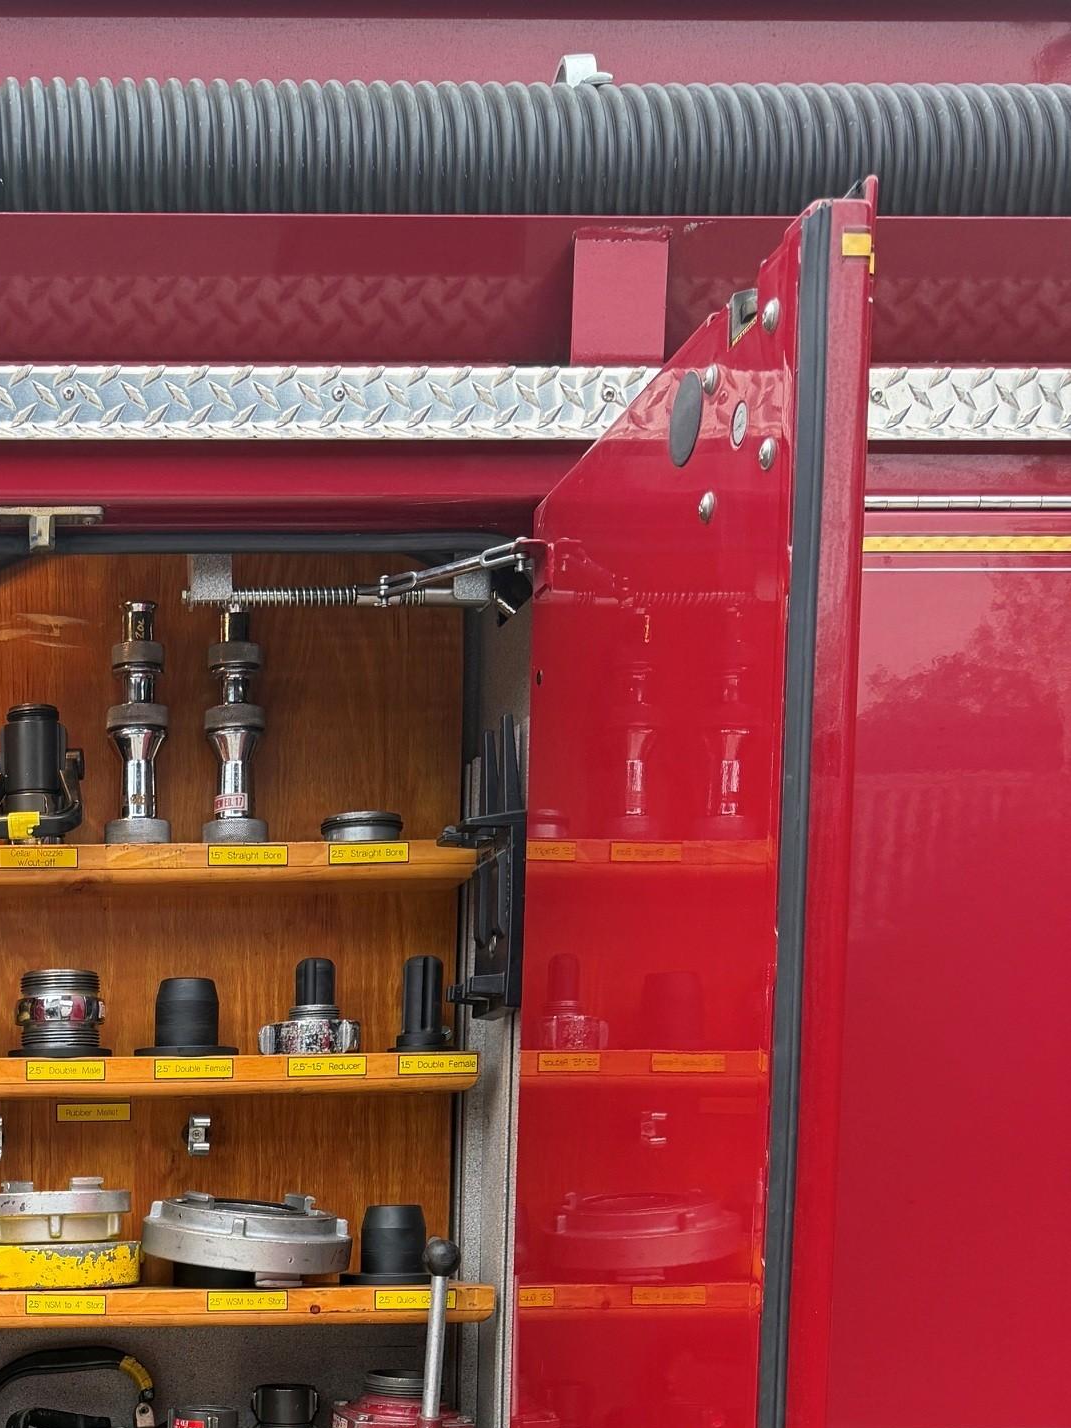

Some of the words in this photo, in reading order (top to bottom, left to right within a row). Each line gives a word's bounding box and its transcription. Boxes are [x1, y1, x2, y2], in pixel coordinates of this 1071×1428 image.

[10, 849, 32, 858] Cellar
[36, 849, 63, 858] Nozzle
[227, 851, 259, 862] Straight
[263, 851, 282, 860] Bore
[351, 848, 382, 860] Straight
[386, 847, 405, 857] Bore
[17, 857, 57, 867] w/cut-off
[175, 1064, 201, 1073] Double
[205, 1064, 232, 1073] Female
[329, 1061, 362, 1070] Reducer
[417, 1060, 445, 1069] Double
[448, 1060, 476, 1069] Female
[49, 1066, 77, 1075] Double
[81, 1066, 101, 1075] Male
[65, 1109, 92, 1117] Rubber
[268, 1297, 286, 1305] Storz
[396, 1296, 417, 1304] Quick
[44, 1301, 61, 1309] NSM
[64, 1301, 72, 1309] to
[86, 1301, 104, 1309] Storz
